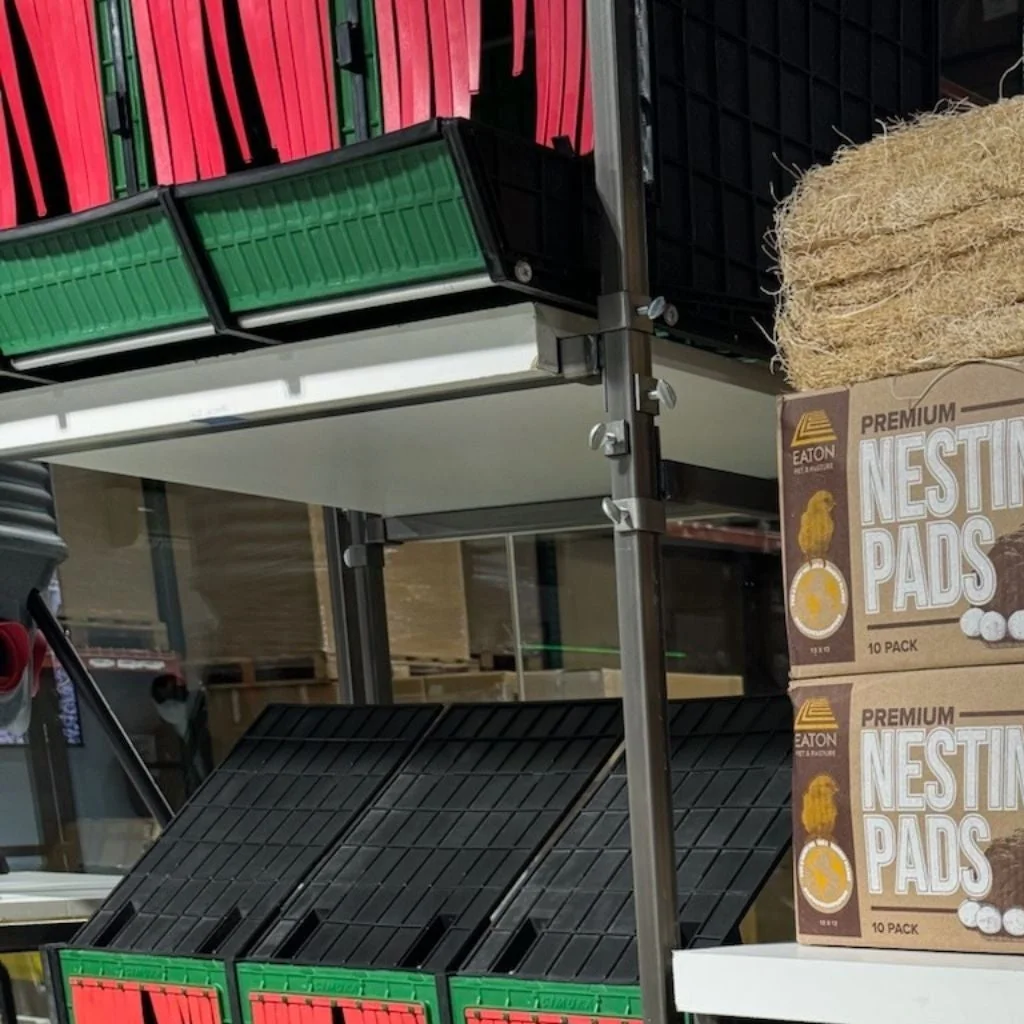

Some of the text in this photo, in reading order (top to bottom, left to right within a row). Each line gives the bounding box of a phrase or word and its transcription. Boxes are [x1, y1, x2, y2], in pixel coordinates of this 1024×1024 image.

[861, 402, 956, 434] PREMIUM
[792, 445, 836, 466] EATON
[863, 515, 998, 615] PADS
[867, 639, 918, 655] 10 PACK
[862, 706, 954, 727] PREMIUM
[795, 732, 837, 748] EATON
[862, 806, 993, 898] PADS
[872, 922, 919, 935] 10 PACK
